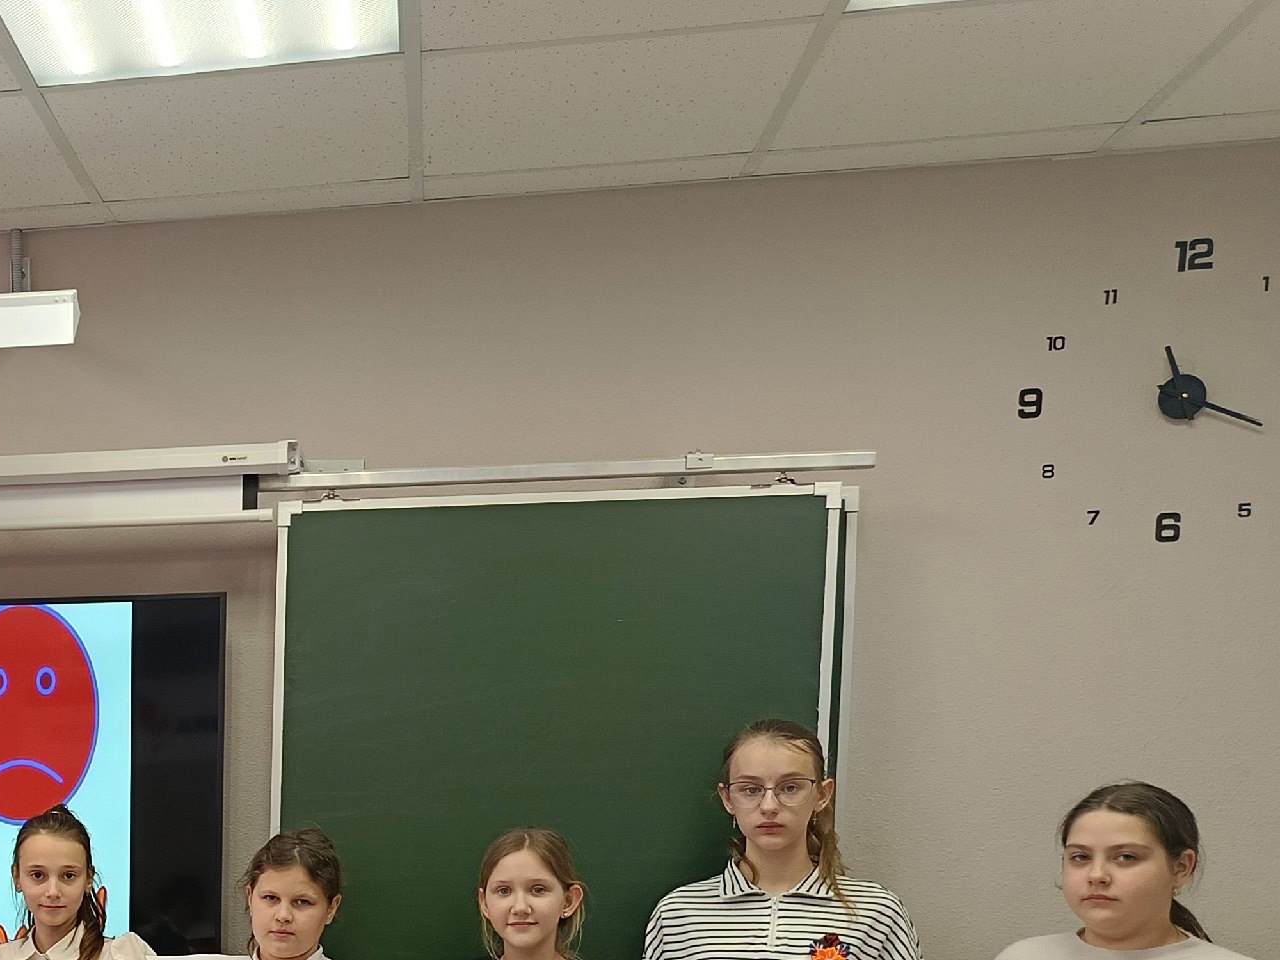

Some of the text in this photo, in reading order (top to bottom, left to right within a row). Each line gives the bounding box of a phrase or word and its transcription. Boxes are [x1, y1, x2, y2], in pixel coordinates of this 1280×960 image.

[1174, 237, 1215, 273] 12
[1262, 275, 1270, 292] 1
[1103, 288, 1118, 306] 11
[1045, 335, 1067, 352] 10
[1017, 387, 1044, 420] 9
[1041, 463, 1055, 479] 8
[1086, 509, 1101, 526] 7
[1237, 501, 1252, 518] 5
[1154, 511, 1182, 543] 6
